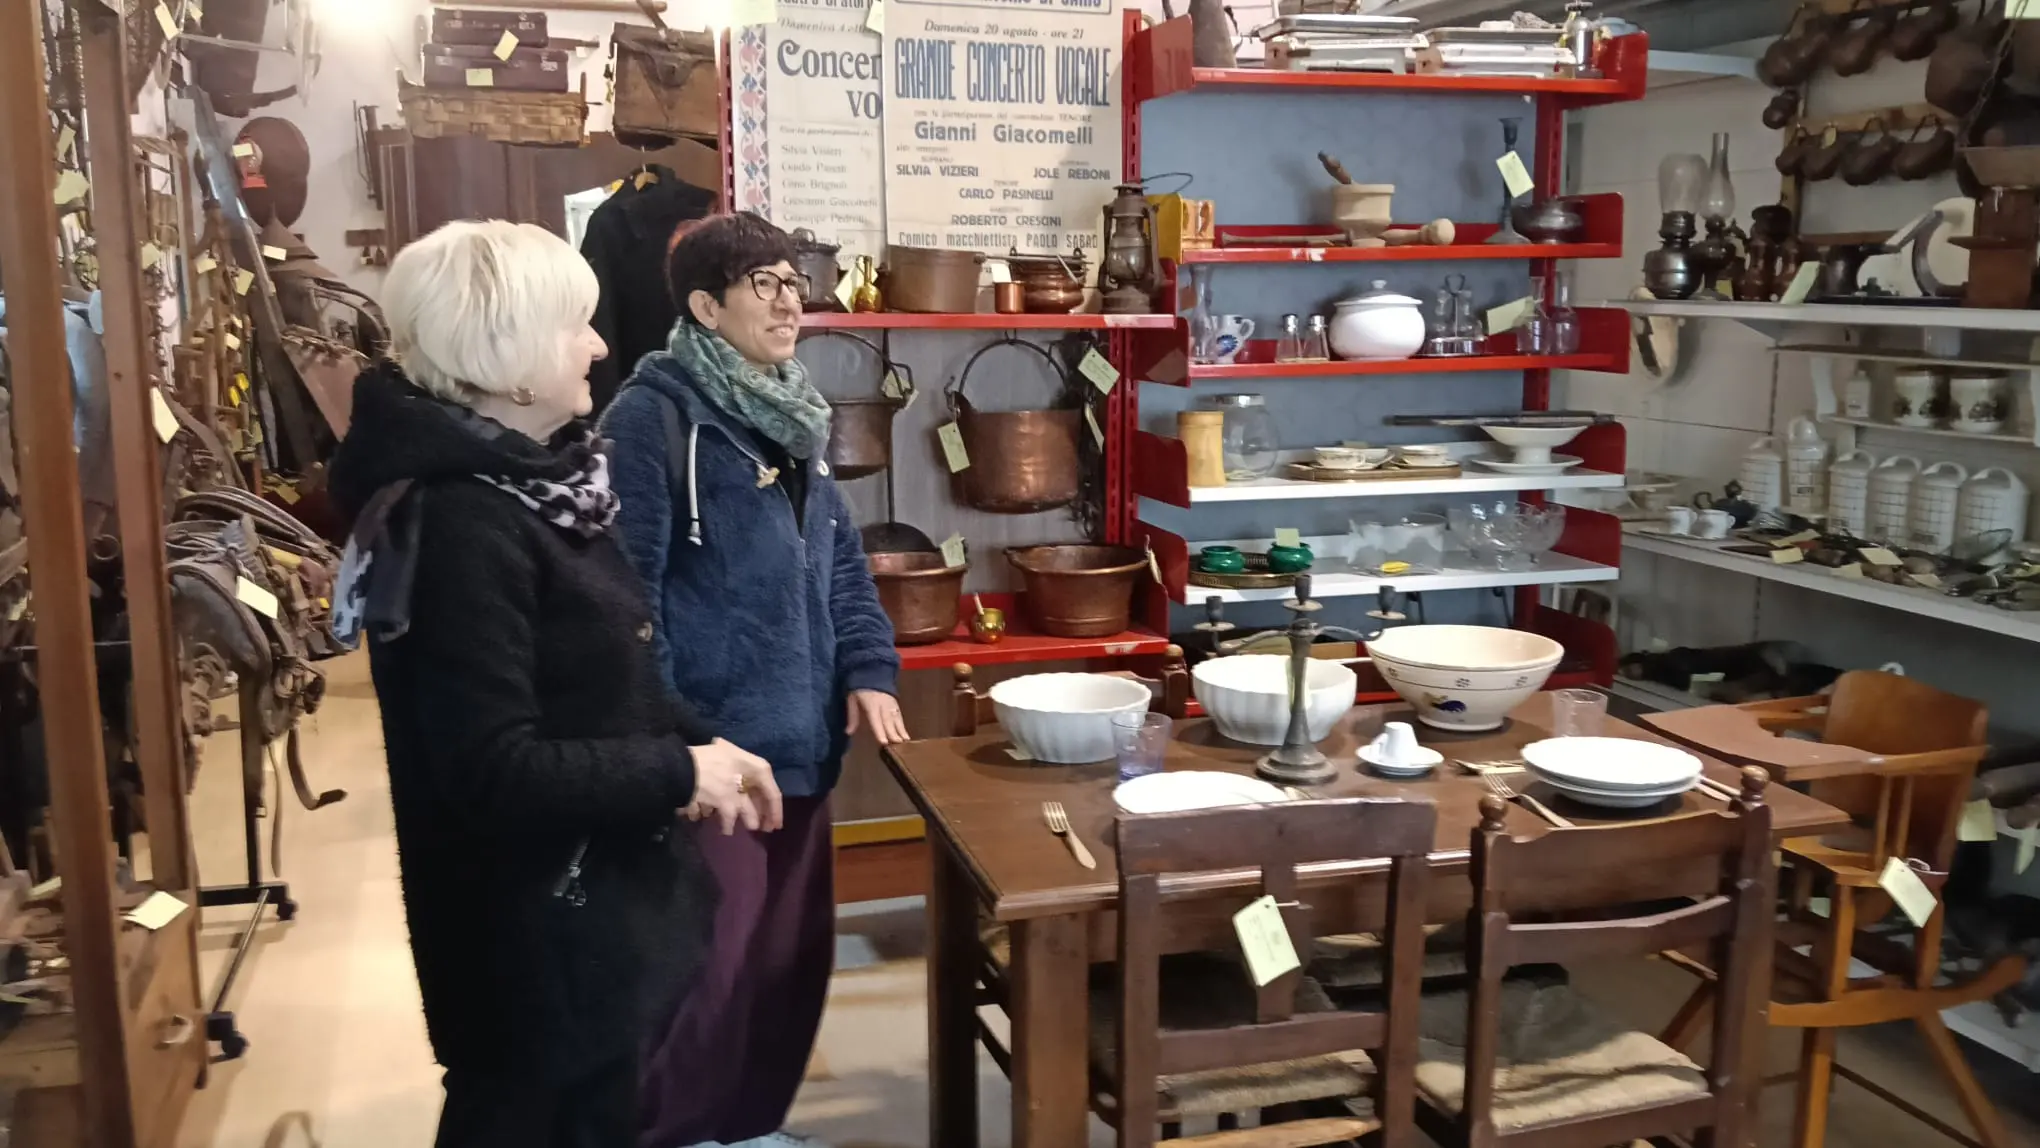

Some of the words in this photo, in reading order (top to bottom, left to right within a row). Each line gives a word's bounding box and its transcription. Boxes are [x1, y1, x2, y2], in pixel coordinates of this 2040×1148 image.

[924, 19, 979, 34] Domenica
[985, 24, 999, 35] 20
[1003, 27, 1038, 38] agosto
[1050, 30, 1068, 39] ore
[1072, 28, 1084, 39] 21
[777, 39, 882, 80] Concer
[895, 37, 956, 100] GRANDE
[966, 40, 1045, 104] CONCERTO
[1055, 45, 1111, 106] VOCALE
[915, 121, 977, 141] Gianni
[993, 124, 1093, 145] Giacomelli
[896, 164, 931, 176] SILVIA
[940, 165, 979, 177] VIZIERI
[1033, 167, 1060, 179] JOLE
[1068, 168, 1111, 180] REBONI
[958, 188, 995, 200] CARLO
[1003, 189, 1053, 201] PASINELLI
[951, 214, 1008, 226] ROBERTO
[898, 231, 938, 246] Comico
[946, 232, 1018, 248] macchiettista
[1026, 233, 1058, 248] PAOLO
